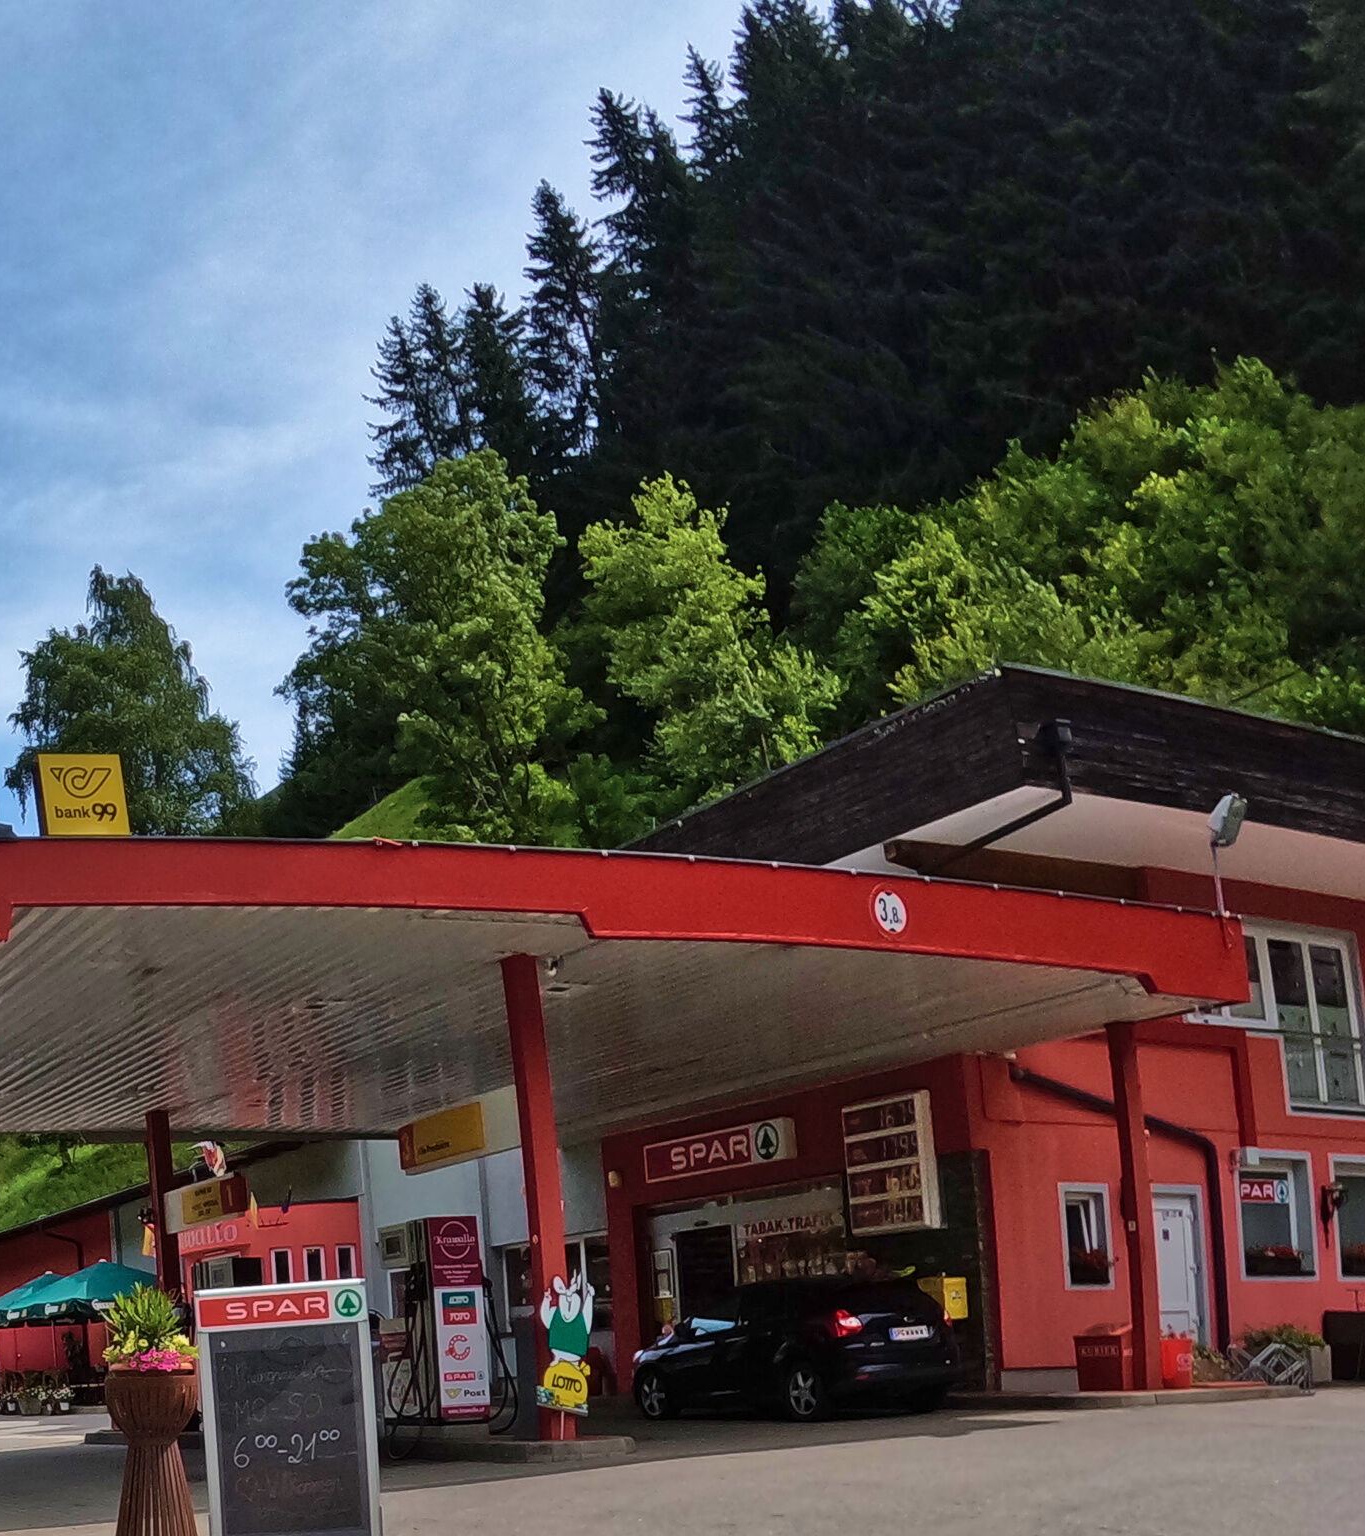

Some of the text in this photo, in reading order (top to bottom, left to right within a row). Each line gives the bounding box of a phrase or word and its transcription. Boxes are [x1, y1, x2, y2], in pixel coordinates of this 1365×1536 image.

[670, 1134, 748, 1171] SPAR
[1240, 1183, 1274, 1198] PAR
[226, 1297, 326, 1320] SPAR
[449, 1312, 470, 1321] TOTO
[445, 1372, 475, 1380] SPAR
[552, 1374, 582, 1393] LOTTO
[463, 1389, 486, 1397] Post
